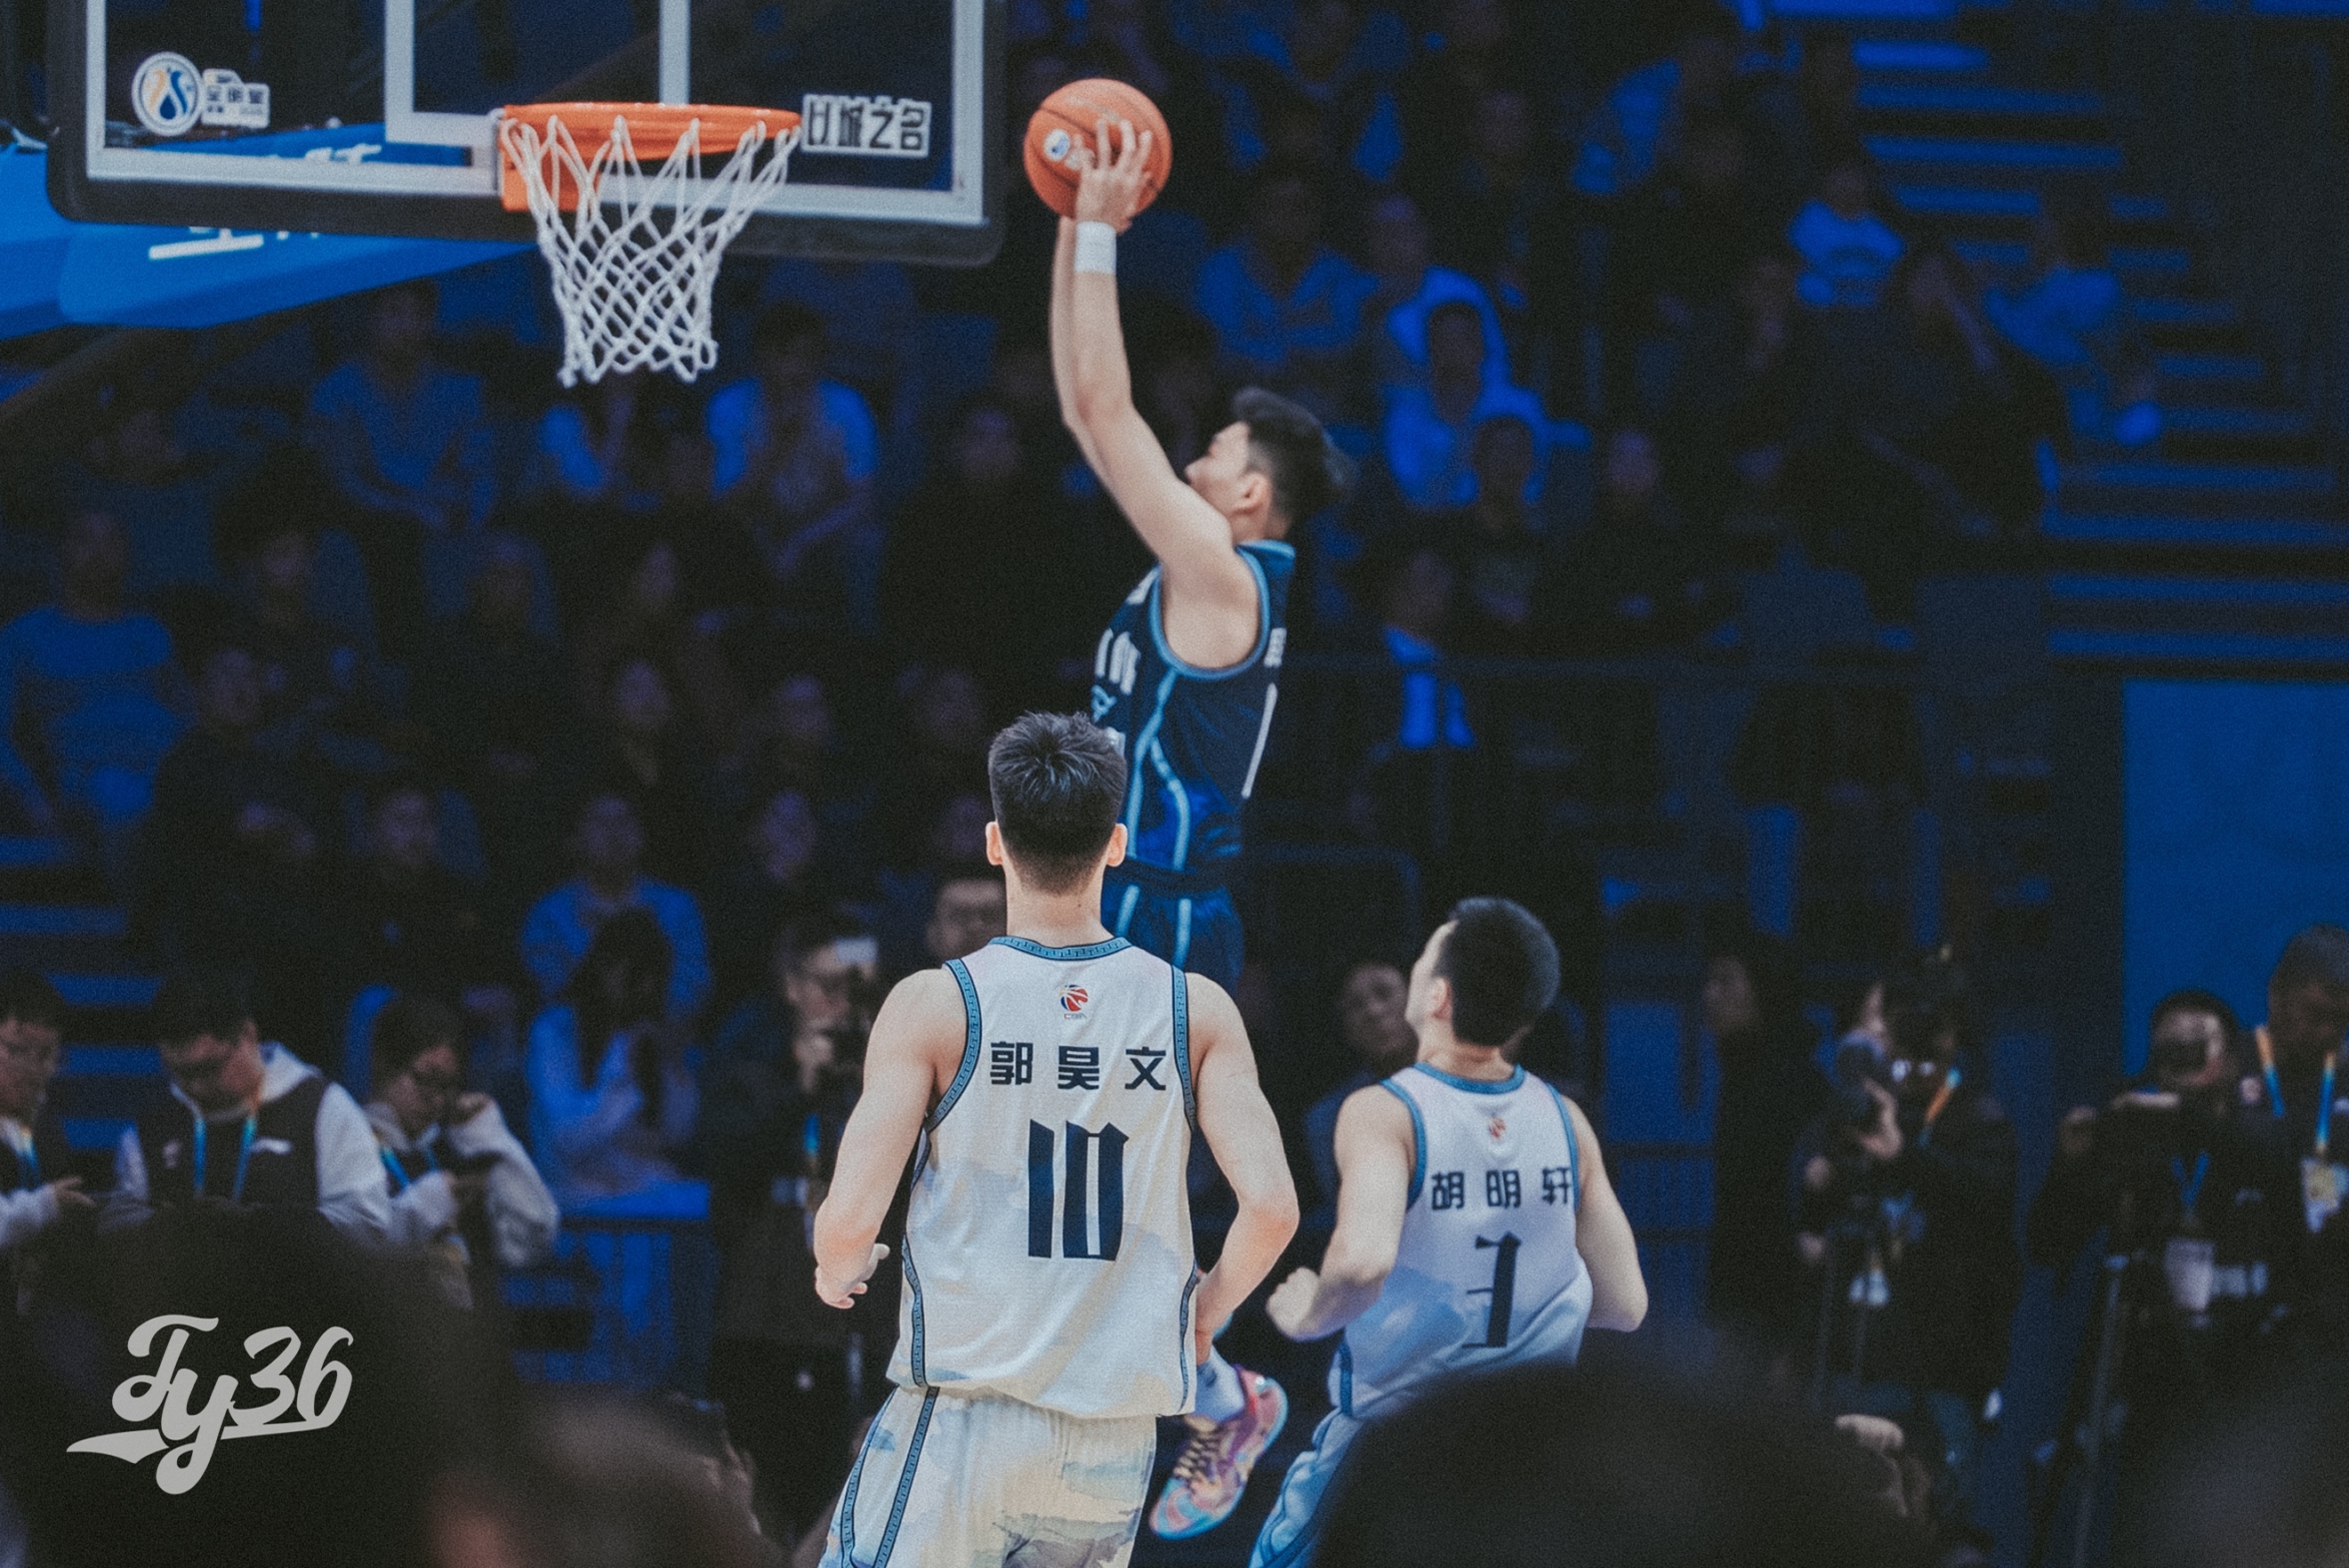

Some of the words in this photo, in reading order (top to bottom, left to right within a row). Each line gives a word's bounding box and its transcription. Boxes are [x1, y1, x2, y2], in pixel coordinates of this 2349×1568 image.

[990, 1041, 1166, 1090] 郭昊文
[1028, 1119, 1130, 1261] 10
[1431, 1167, 1571, 1210] 胡明轩
